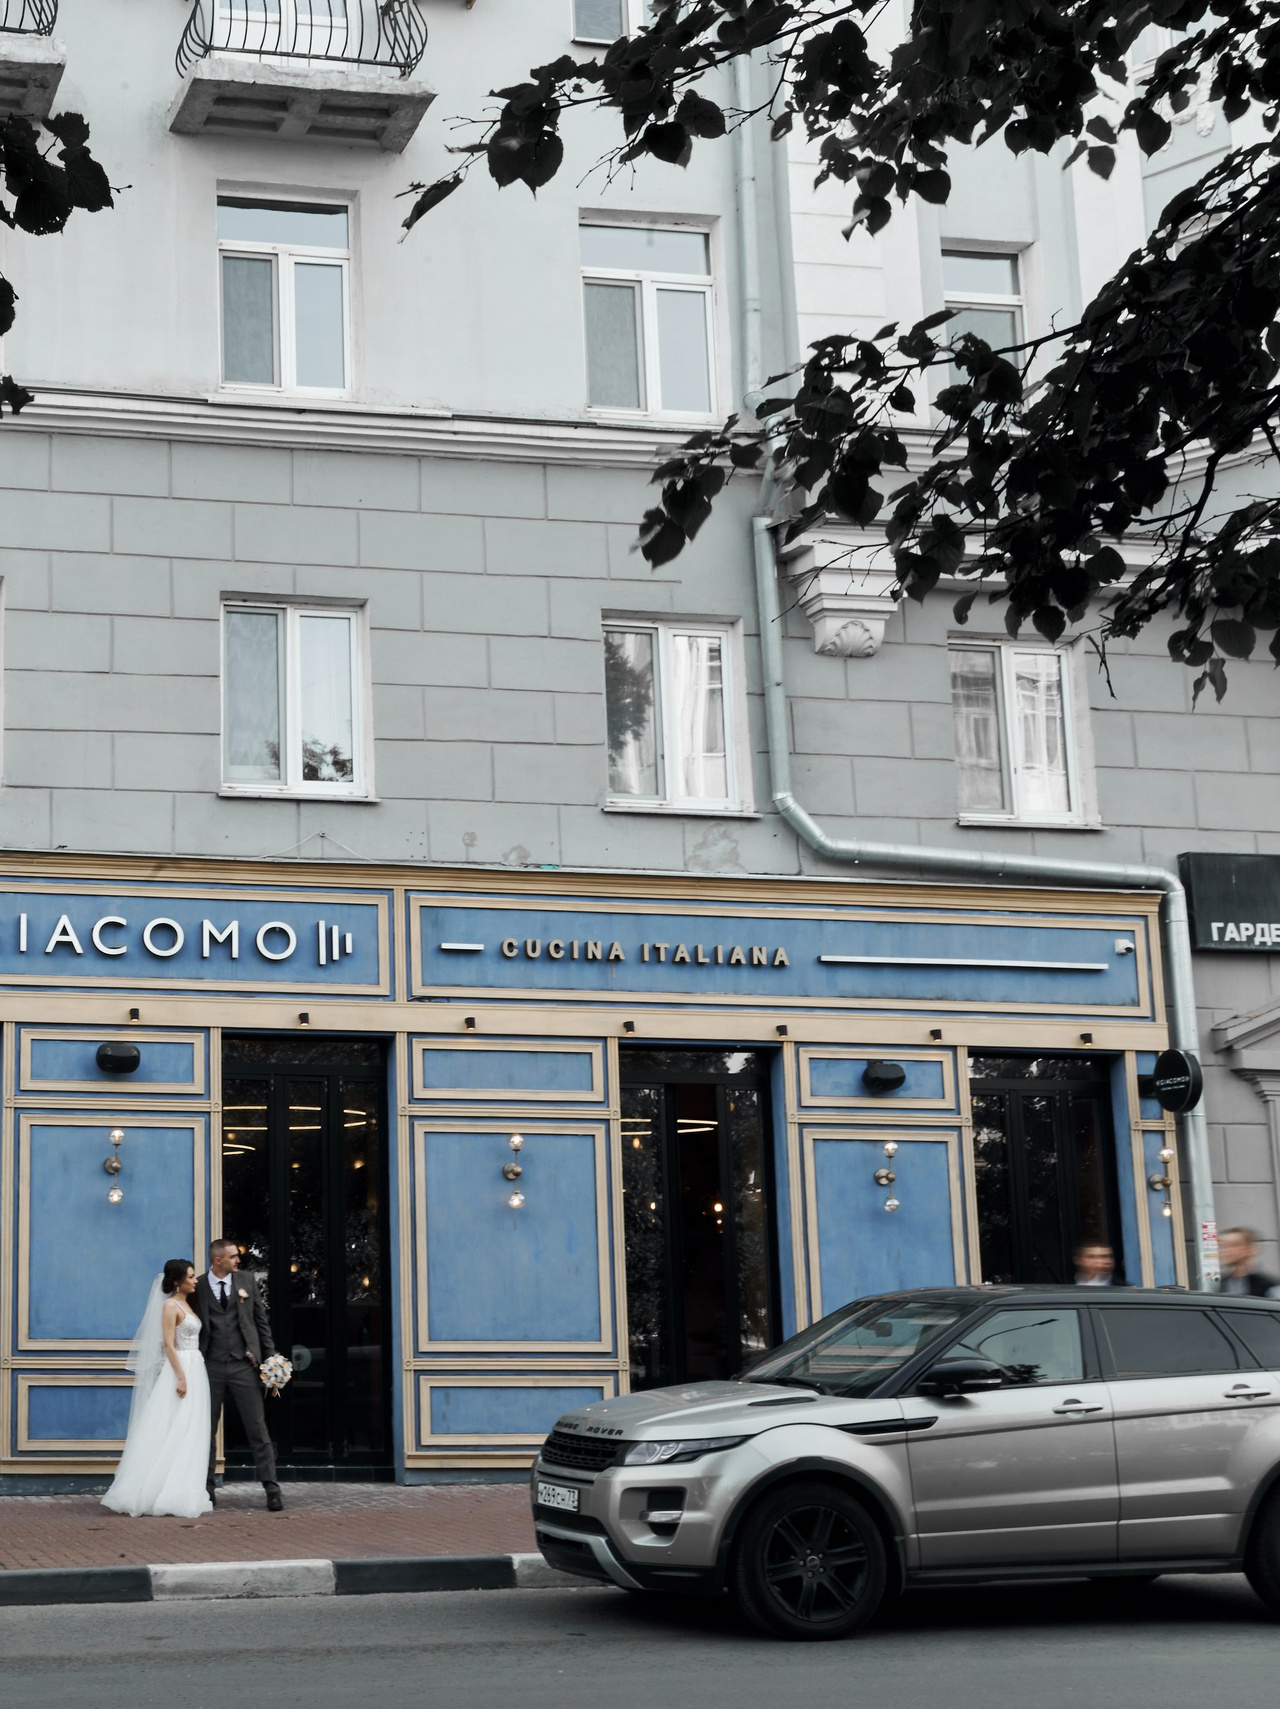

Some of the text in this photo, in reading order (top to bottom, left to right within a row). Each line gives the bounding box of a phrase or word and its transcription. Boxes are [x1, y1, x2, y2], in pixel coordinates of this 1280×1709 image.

[501, 937, 791, 967] CUCINA ITALIANA
[586, 1426, 624, 1437] ROVER
